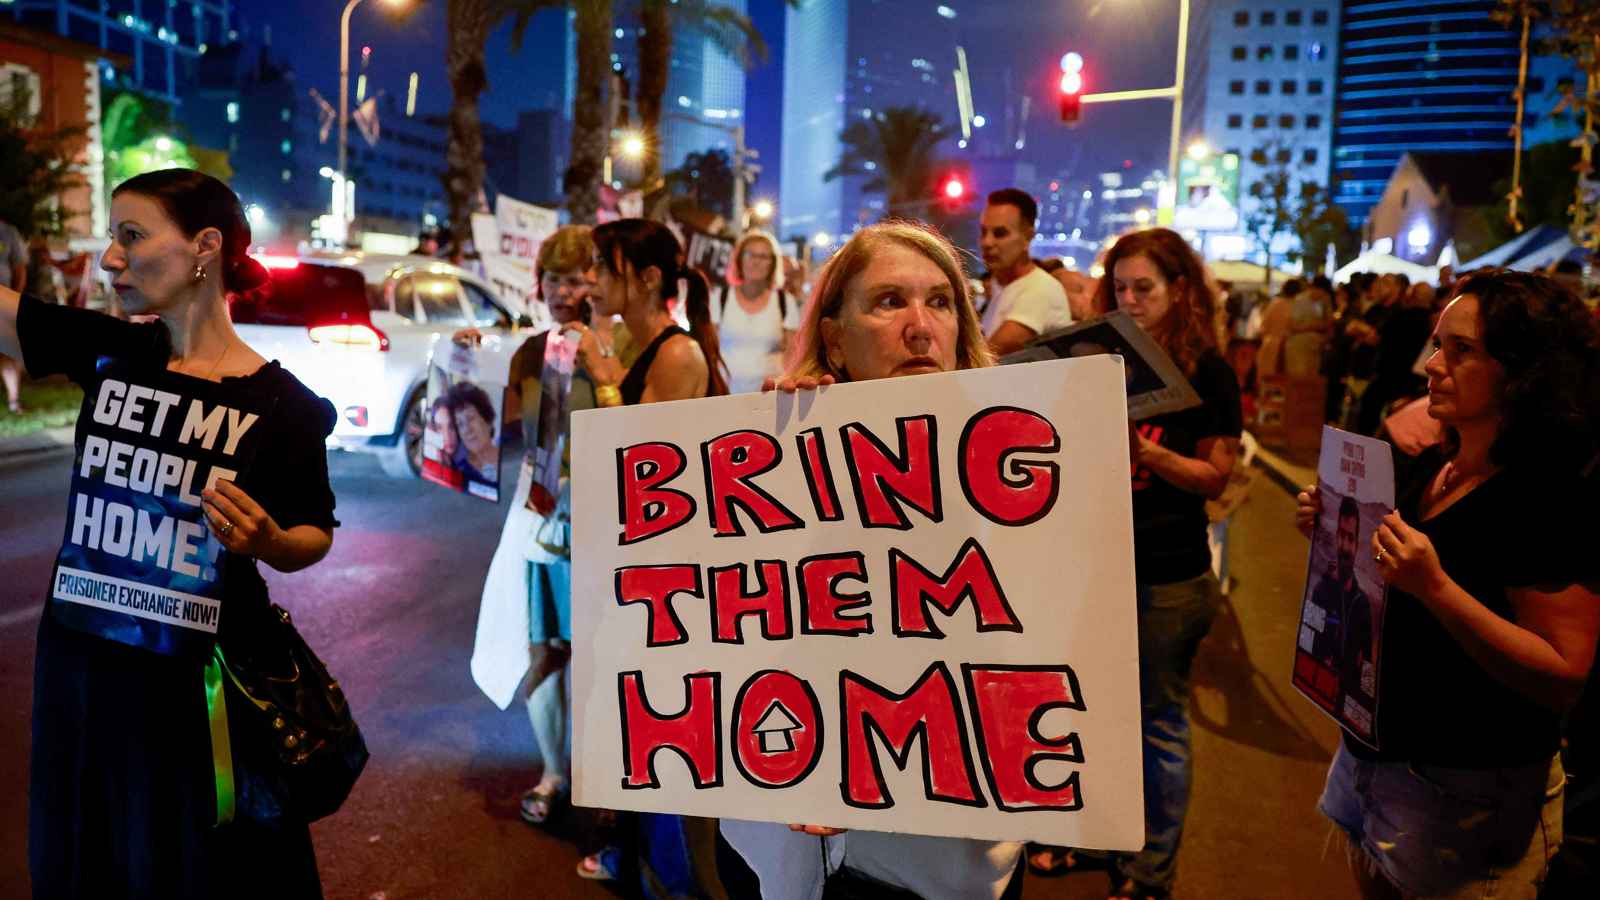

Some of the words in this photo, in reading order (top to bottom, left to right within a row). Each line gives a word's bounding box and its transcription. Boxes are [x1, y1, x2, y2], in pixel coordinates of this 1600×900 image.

[92, 378, 181, 438] GET
[178, 400, 261, 456] MY
[616, 405, 1061, 545] BRING
[71, 494, 221, 581] HOME!
[58, 572, 116, 604] PRISONER
[118, 586, 181, 619] EXCHANGE
[182, 601, 218, 627] NOW!
[614, 537, 1023, 647] THEM
[617, 661, 1087, 813] HOME
